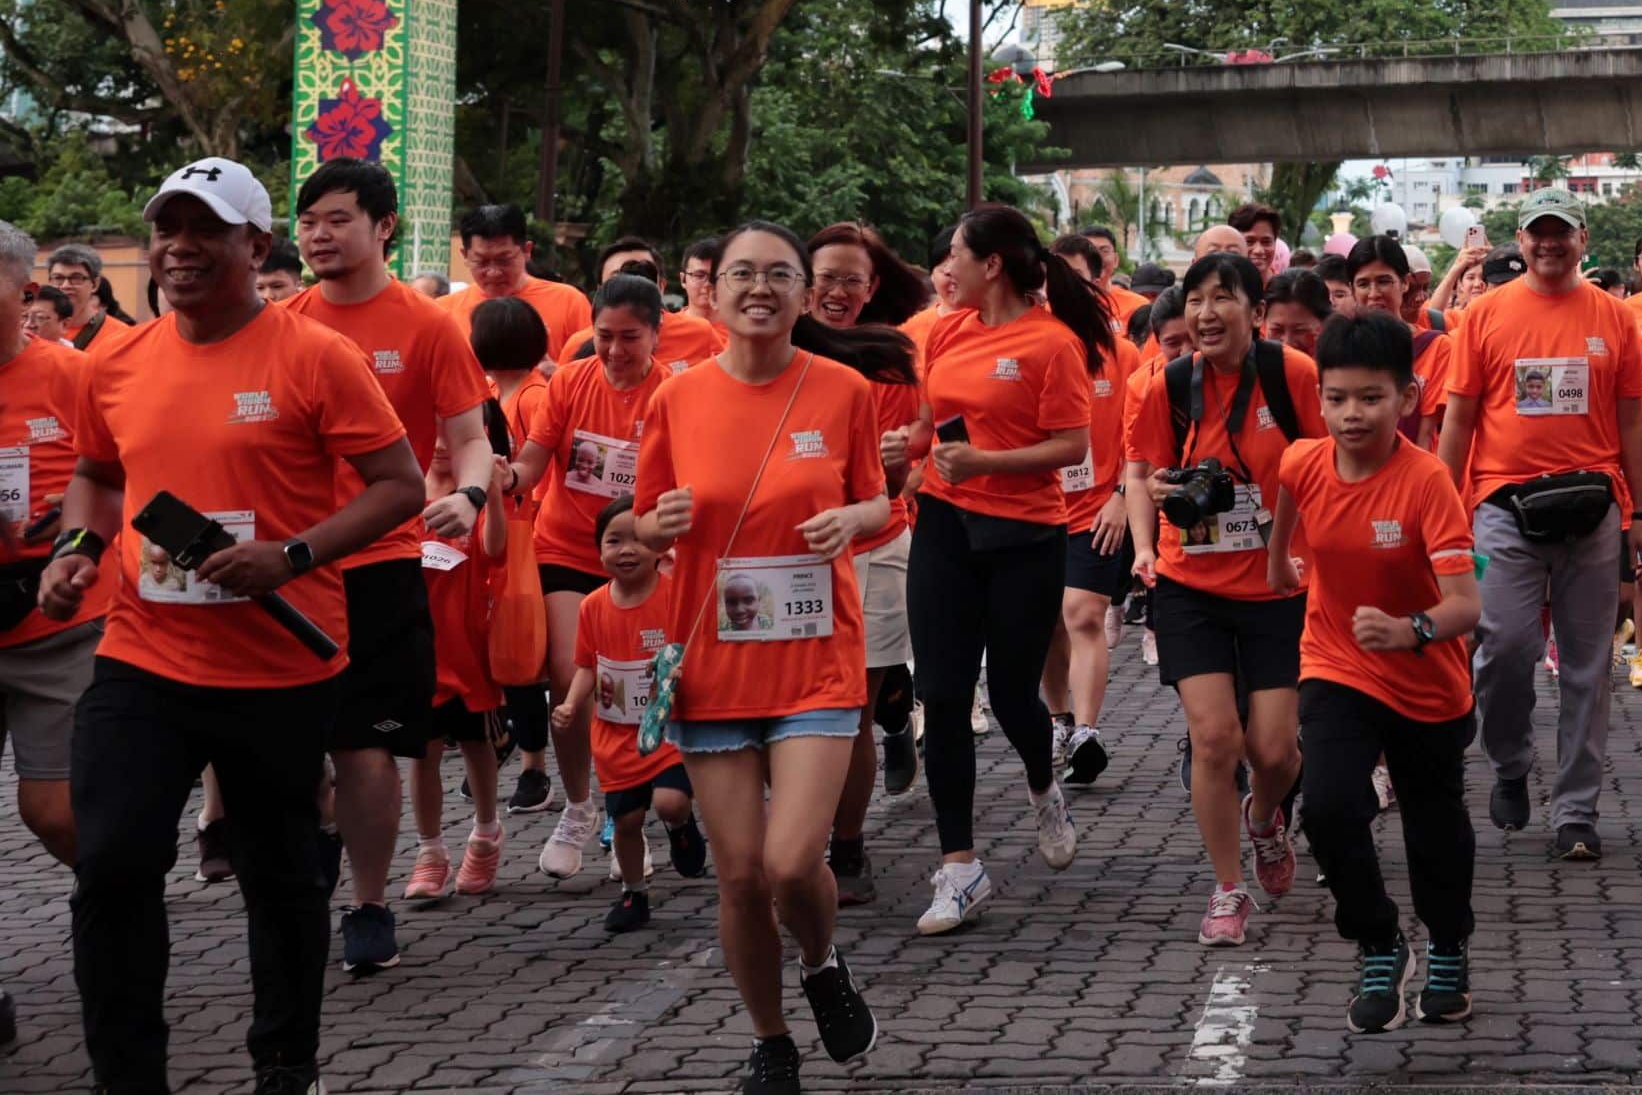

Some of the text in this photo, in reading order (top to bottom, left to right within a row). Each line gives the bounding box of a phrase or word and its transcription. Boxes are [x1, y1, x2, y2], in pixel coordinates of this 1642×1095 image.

[375, 360, 402, 370] RUN
[1558, 387, 1583, 399] 0498
[237, 403, 271, 416] RUN
[795, 441, 823, 454] RUN
[610, 472, 637, 485] 1027
[1066, 467, 1090, 479] 0812
[1225, 520, 1258, 534] 0673
[1376, 532, 1402, 544] RUN
[784, 599, 824, 617] 1333
